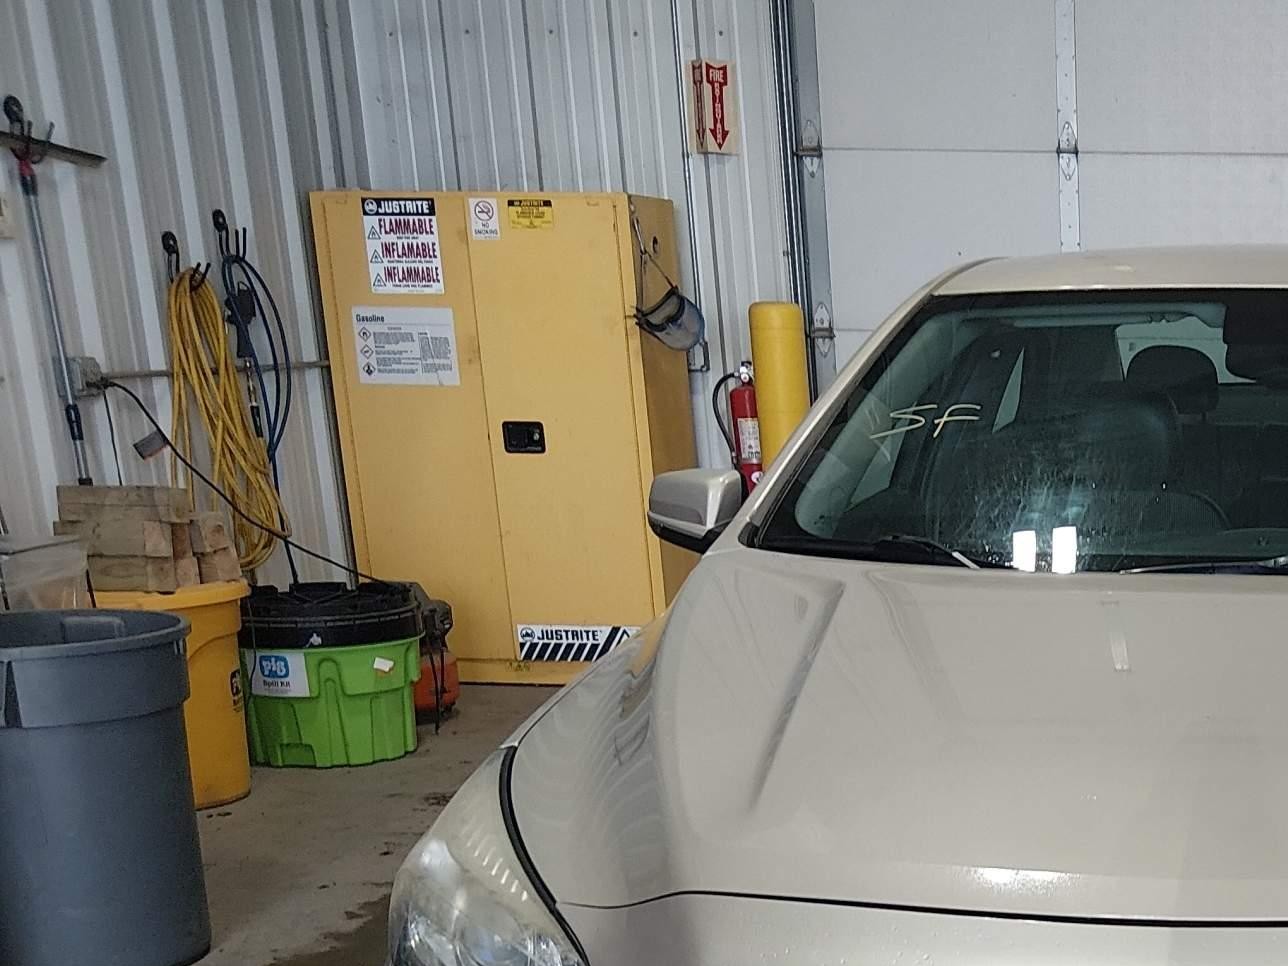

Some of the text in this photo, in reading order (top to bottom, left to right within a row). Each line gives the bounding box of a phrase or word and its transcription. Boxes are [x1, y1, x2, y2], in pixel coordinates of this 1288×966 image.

[709, 69, 724, 82] FIRE
[378, 200, 430, 214] JUSTRITE
[378, 218, 434, 235] FLAMMABLE
[381, 241, 438, 259] INFLAMABLE
[383, 266, 441, 284] INFLAMMABLE
[355, 313, 385, 323] Gasoline
[537, 629, 600, 641] JUSTRITE
[262, 657, 286, 676] pig
